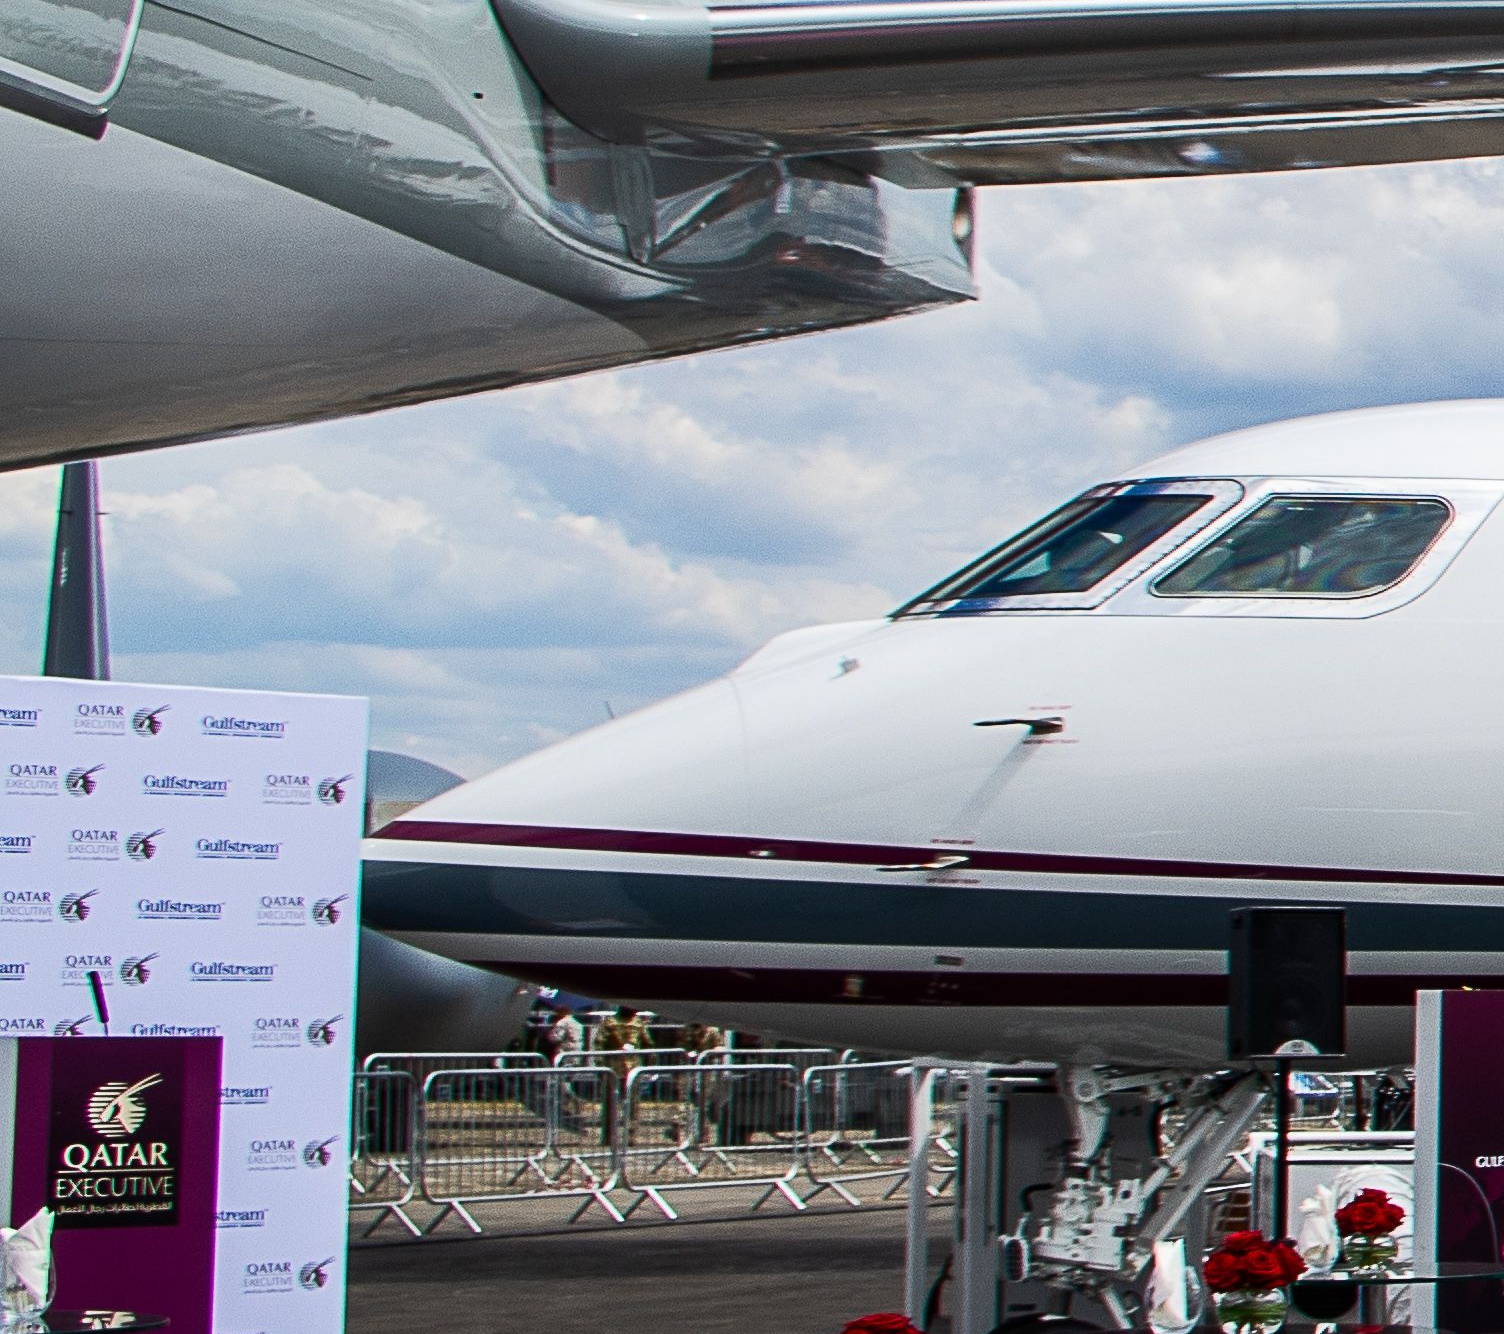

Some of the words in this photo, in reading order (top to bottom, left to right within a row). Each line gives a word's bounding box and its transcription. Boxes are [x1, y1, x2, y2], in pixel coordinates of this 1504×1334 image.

[78, 704, 124, 716] QATAR
[203, 716, 284, 731] Gulfstream
[10, 764, 57, 776] QATAR
[144, 775, 227, 790] Gulfstream
[266, 774, 310, 786] QATAR
[72, 830, 118, 842] QATAR
[197, 839, 279, 853] Gulfstream
[3, 891, 51, 903] QATAR
[262, 896, 304, 908] QATAR
[138, 898, 221, 913] Gulfstream
[66, 955, 112, 967] QATAR
[192, 962, 273, 975] Gulfstream
[256, 1018, 299, 1030] QATAR
[251, 1139, 295, 1152] QATAR
[63, 1142, 168, 1172] QATAR
[56, 1176, 173, 1198] EXECUTIVE
[246, 1262, 291, 1275] QATAR
